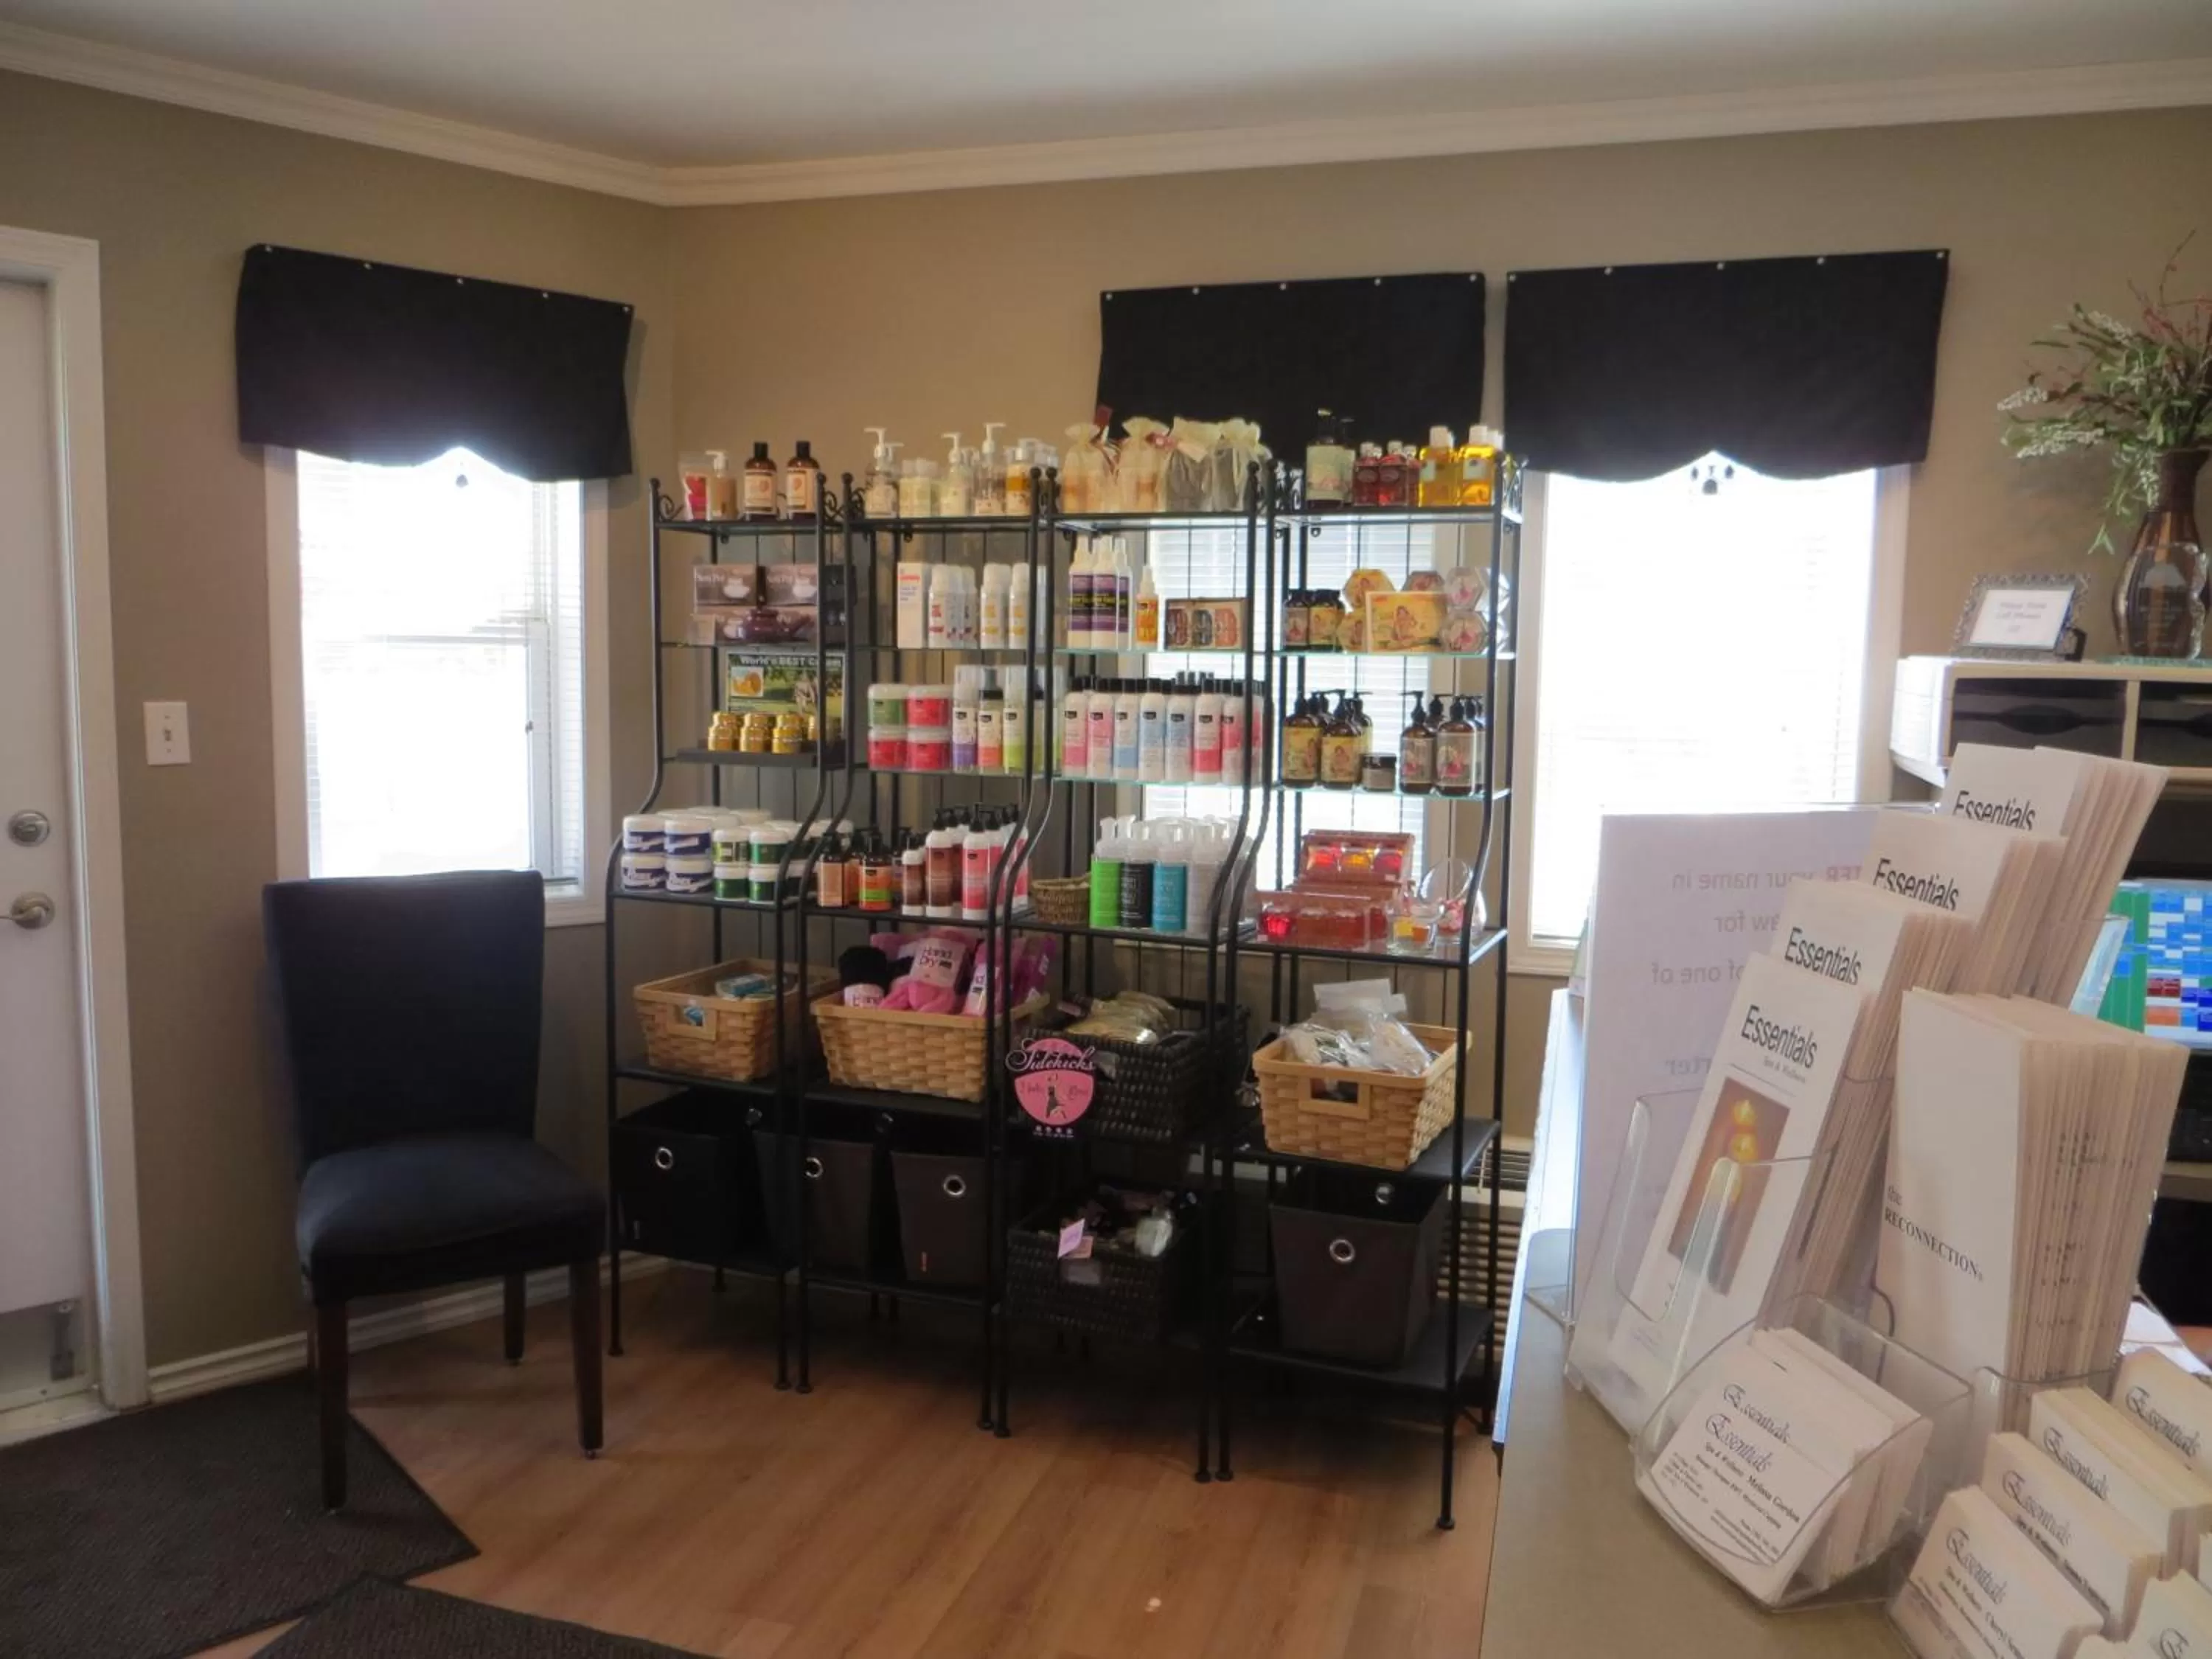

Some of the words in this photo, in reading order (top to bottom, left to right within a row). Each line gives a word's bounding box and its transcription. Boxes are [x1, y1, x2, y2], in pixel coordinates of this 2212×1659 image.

[1952, 790, 2036, 830] Essentials
[1873, 858, 1959, 911] Essentials
[1784, 926, 1862, 986] Essentials
[1005, 1038, 1096, 1072] Sidekicks
[1741, 1004, 1818, 1069] Essentials
[1705, 1413, 1773, 1473] Essentials
[1723, 1383, 1791, 1444] Essentials
[2125, 1385, 2200, 1458] Essentials
[2043, 1427, 2110, 1501] Essentials
[2002, 1470, 2073, 1547] Essentials
[1947, 1526, 2008, 1605] Essentials
